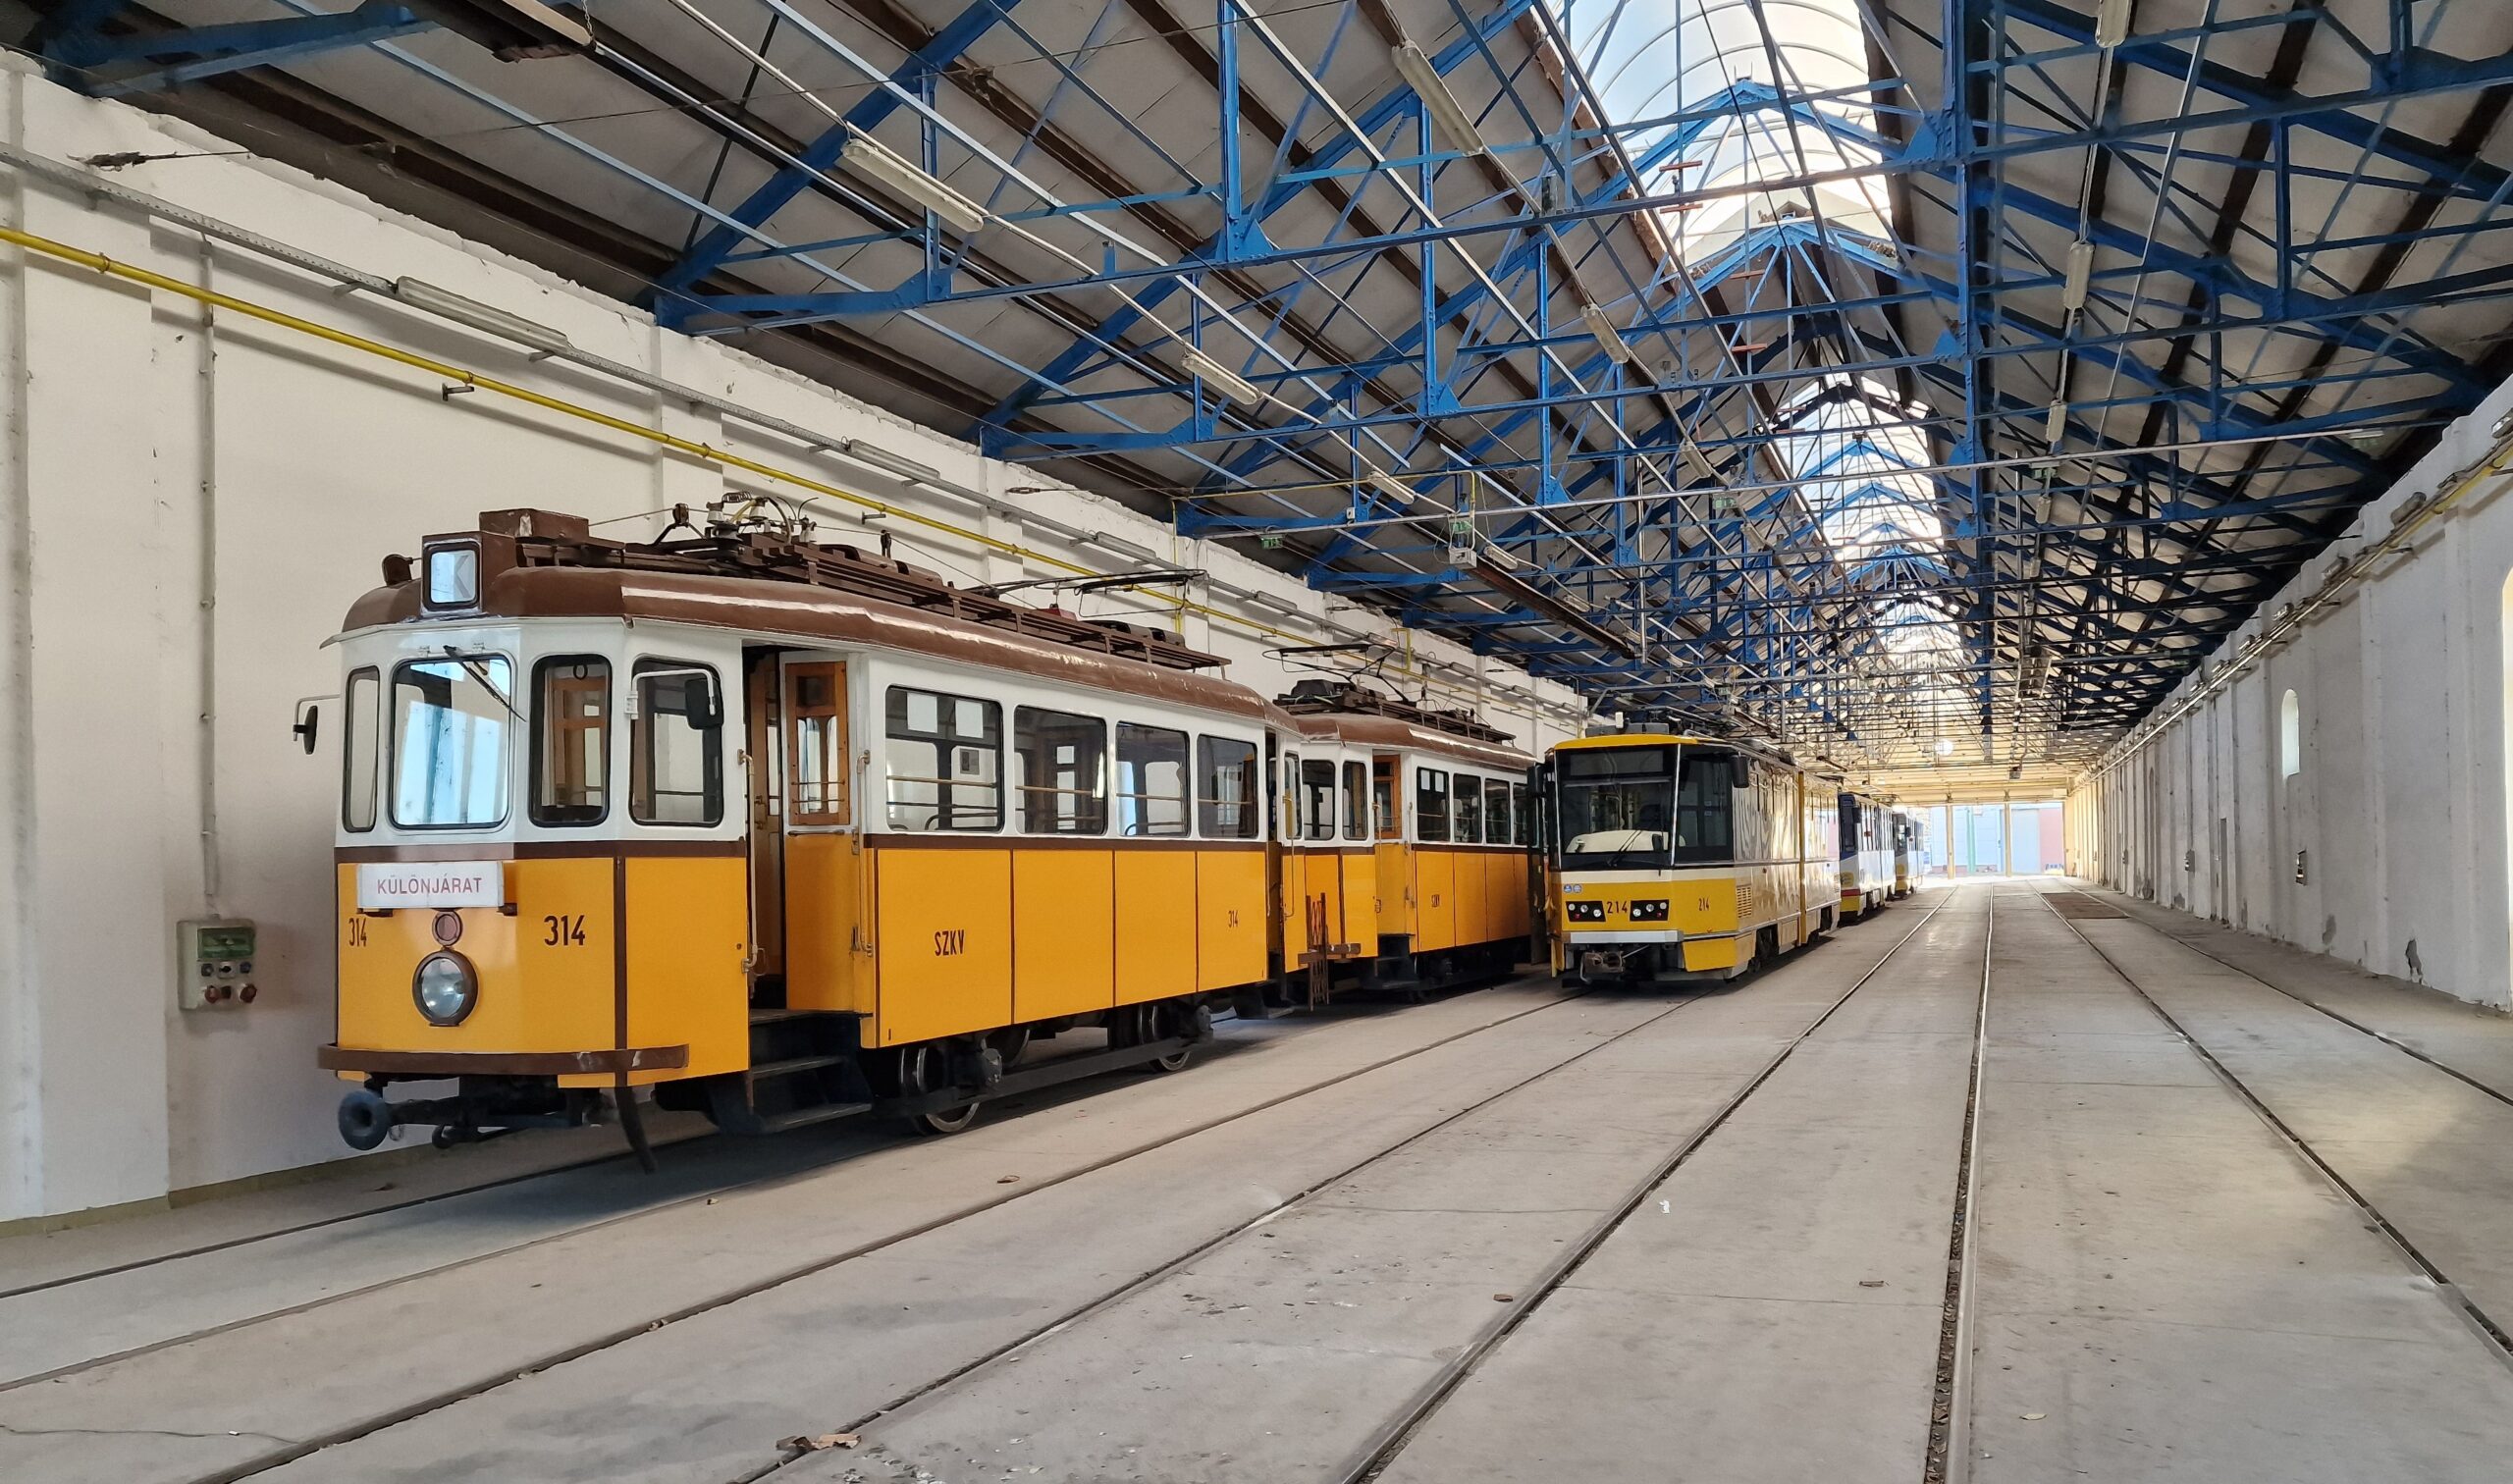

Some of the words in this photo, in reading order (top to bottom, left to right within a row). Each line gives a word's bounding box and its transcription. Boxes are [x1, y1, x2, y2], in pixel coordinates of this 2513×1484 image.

[377, 873, 482, 895] KÜLÖNJÁRAT
[1606, 901, 1628, 915] 214
[1698, 897, 1710, 912] 214
[1228, 910, 1239, 928] 314
[348, 918, 368, 947] 314
[544, 915, 586, 946] 314
[934, 928, 965, 957] SZKV
